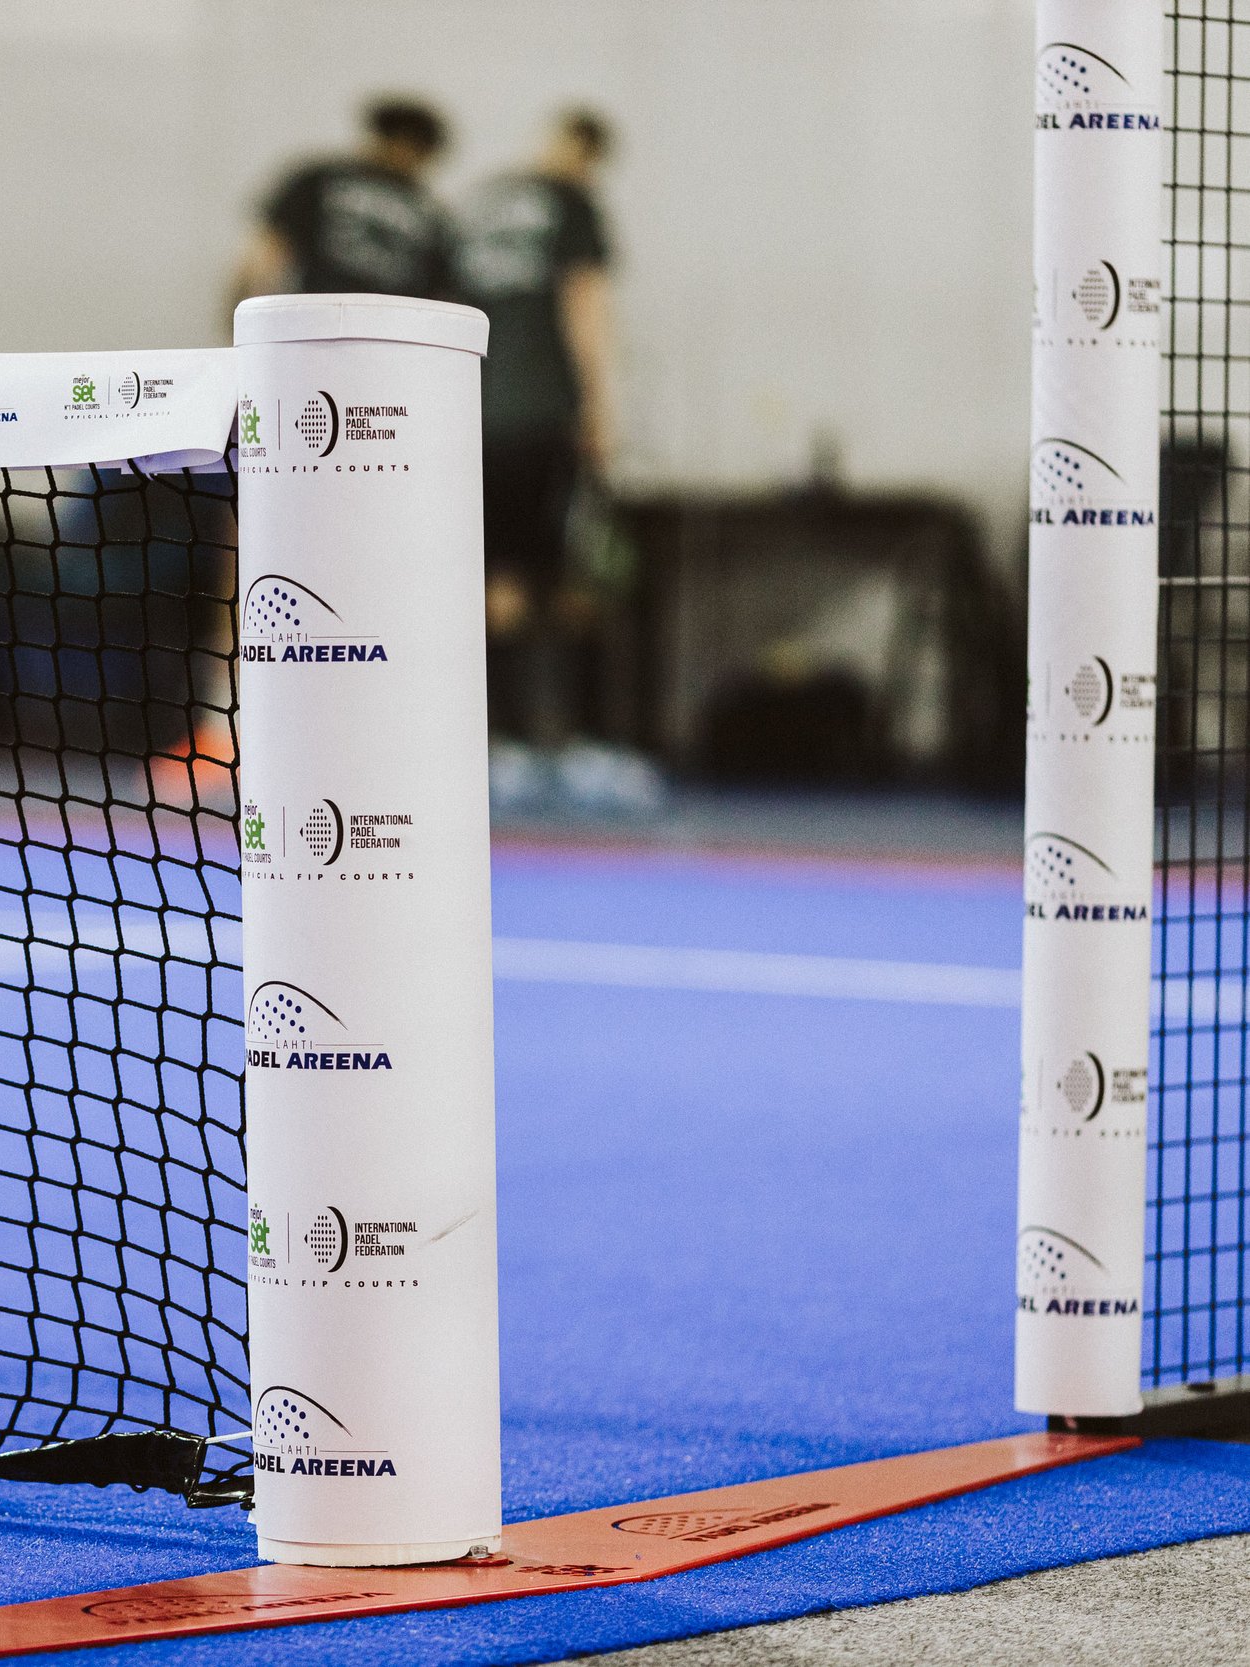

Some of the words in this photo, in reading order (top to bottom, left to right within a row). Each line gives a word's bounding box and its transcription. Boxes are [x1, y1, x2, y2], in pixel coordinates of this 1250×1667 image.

[1070, 113, 1159, 129] AREENA
[73, 374, 90, 385] mejor
[73, 381, 95, 402] set
[346, 406, 408, 417] INTERNATIONAL
[346, 418, 371, 428] PADEL
[346, 429, 395, 440] FEDERATION
[250, 448, 266, 457] COURTS
[1063, 509, 1153, 525] AREENA
[272, 633, 307, 642] LAHTI
[282, 645, 387, 662] AREENA
[351, 815, 413, 825] INTERNATIONAL
[245, 813, 265, 849] set
[351, 827, 376, 837] PADEL
[351, 838, 400, 848] FEDERATION
[254, 854, 271, 863] COURTS
[1056, 905, 1147, 920] AREENA
[276, 1040, 312, 1049] LAHTI
[286, 1053, 392, 1070] AREENA
[355, 1222, 417, 1232] INTERNATIONAL
[251, 1218, 270, 1255] set
[355, 1234, 380, 1244] PADEL
[355, 1245, 404, 1256] FEDERATION
[260, 1259, 276, 1268] COURTS
[1046, 1297, 1137, 1315] AREENA
[281, 1444, 316, 1455] LAHTI
[291, 1458, 396, 1476] AREENA
